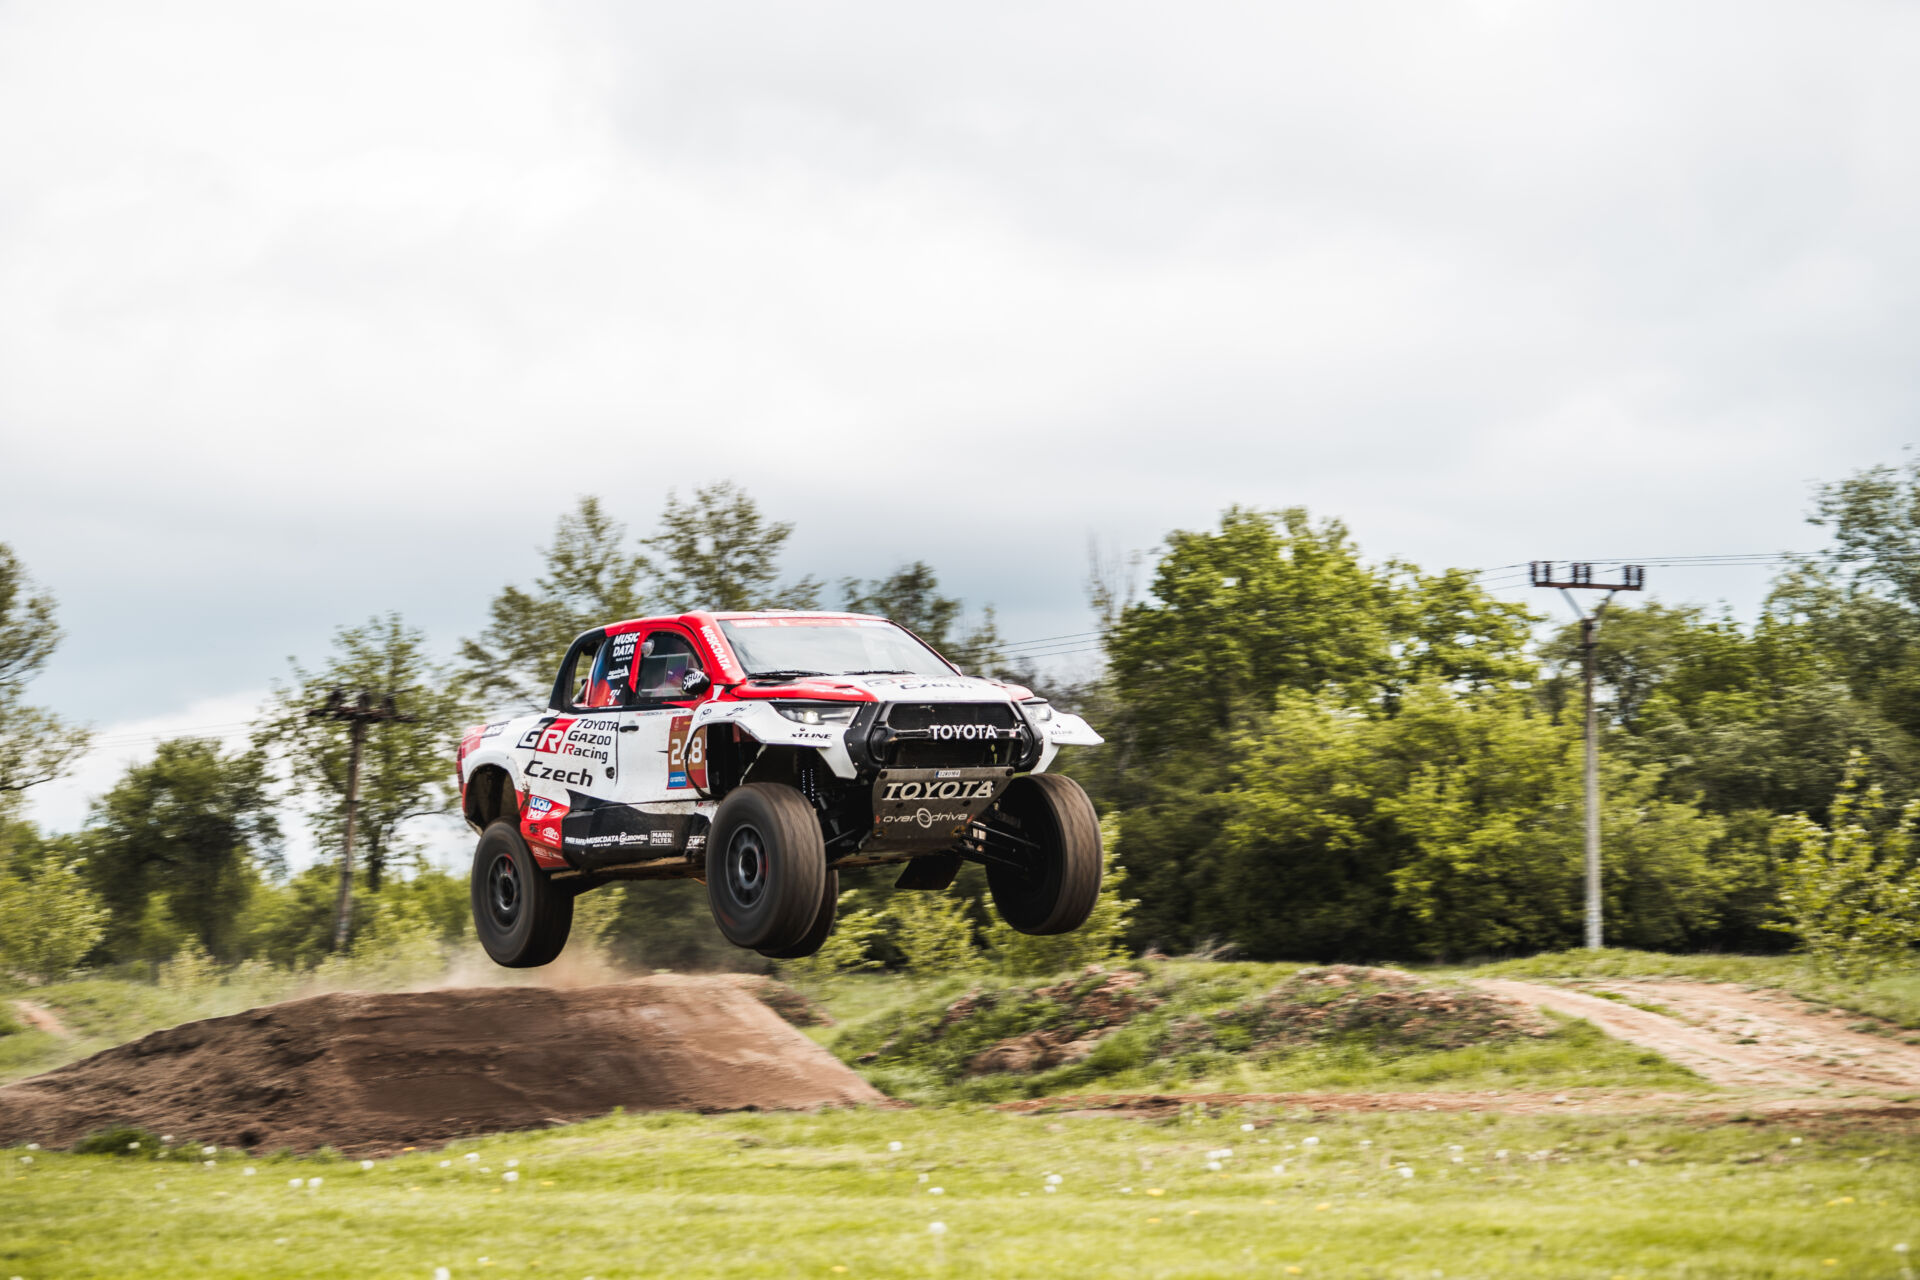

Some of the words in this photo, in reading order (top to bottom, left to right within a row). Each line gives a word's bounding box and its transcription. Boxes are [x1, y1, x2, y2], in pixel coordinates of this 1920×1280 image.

[612, 632, 640, 646] MUSIC
[700, 625, 732, 670] MUSICDATA
[612, 644, 635, 657] DATA
[577, 719, 620, 732] TOYOTA
[929, 723, 998, 740] TOYOTA
[516, 728, 564, 754] GR
[567, 730, 612, 746] GAZOO
[562, 743, 609, 764] Racing
[523, 760, 593, 787] Czech
[884, 780, 993, 800] TOYOTA
[587, 834, 619, 845] MUSICDATA
